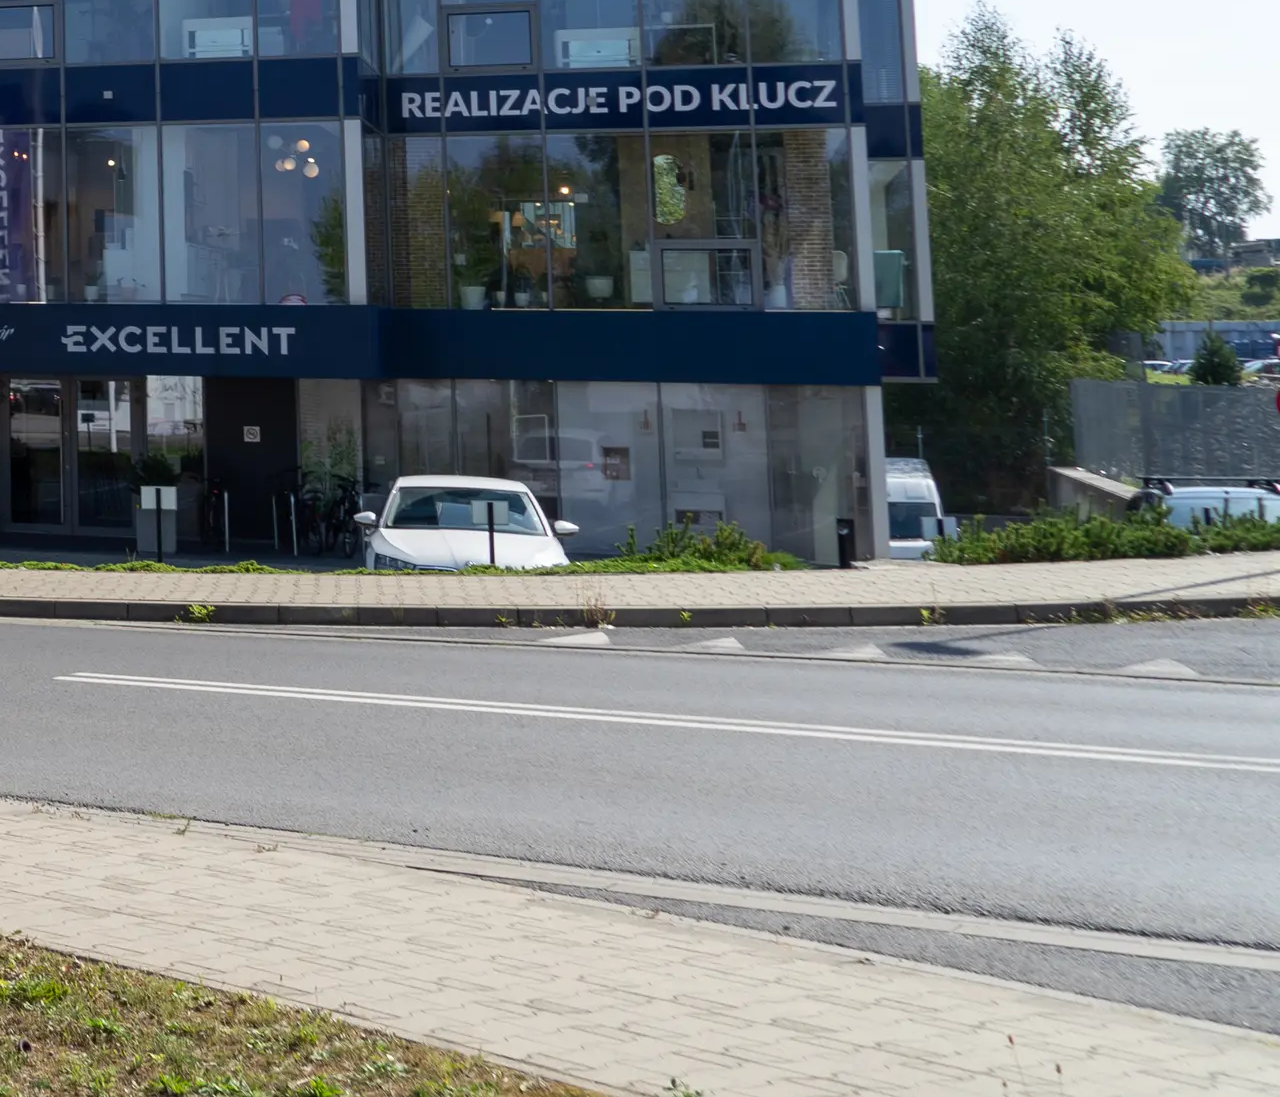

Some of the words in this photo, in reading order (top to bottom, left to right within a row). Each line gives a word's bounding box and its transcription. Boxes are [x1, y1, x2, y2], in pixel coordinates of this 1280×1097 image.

[400, 88, 608, 119] REALIZACJE
[618, 84, 702, 114] POD
[711, 80, 838, 111] KLUCZ
[62, 325, 297, 356] EXCELLENT
